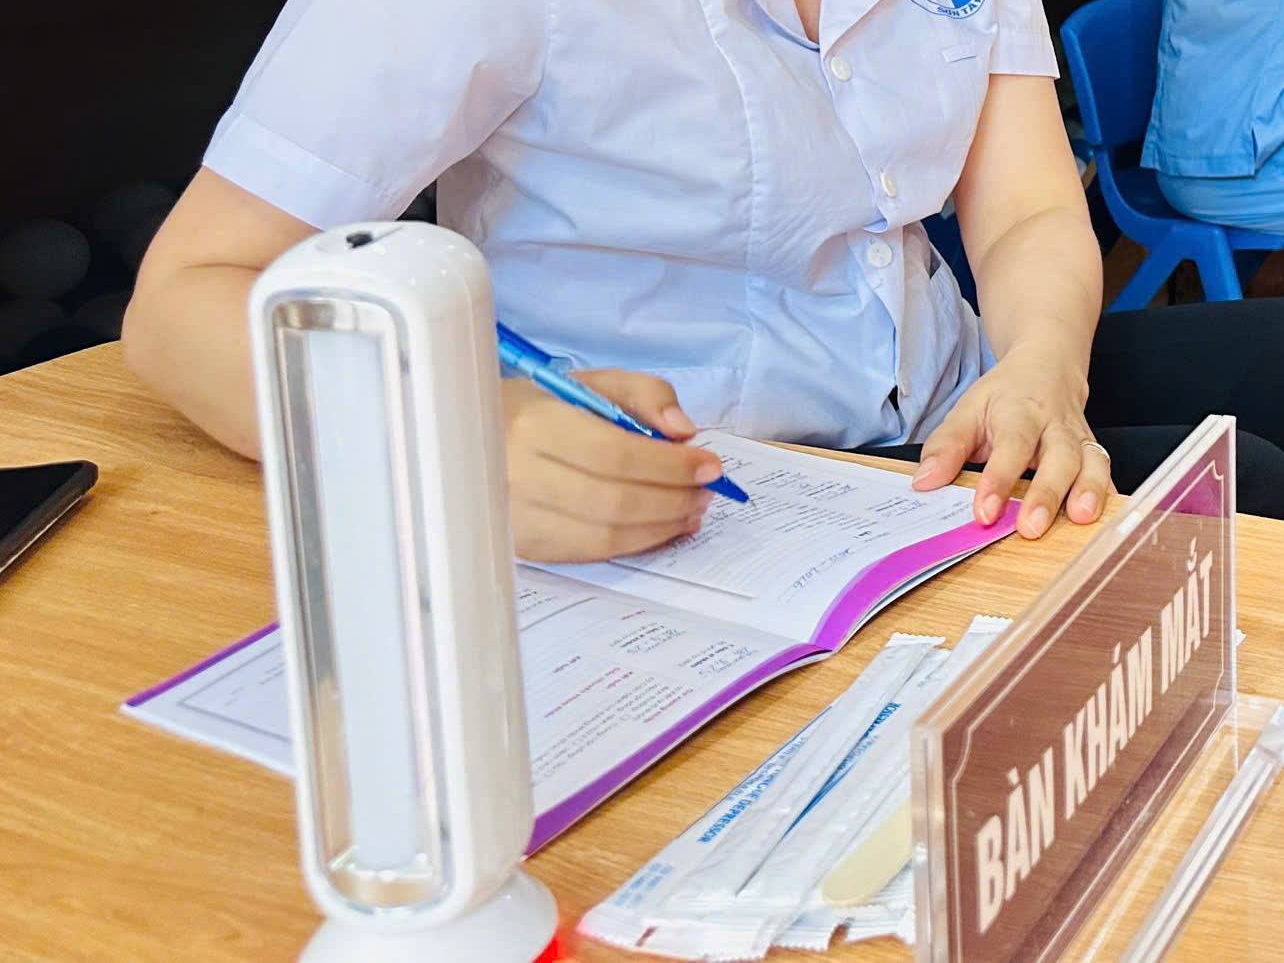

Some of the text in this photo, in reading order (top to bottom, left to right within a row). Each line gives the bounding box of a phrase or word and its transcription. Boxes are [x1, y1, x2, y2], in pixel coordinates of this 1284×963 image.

[976, 536, 1213, 935] BÀN KHÁM MẮT
